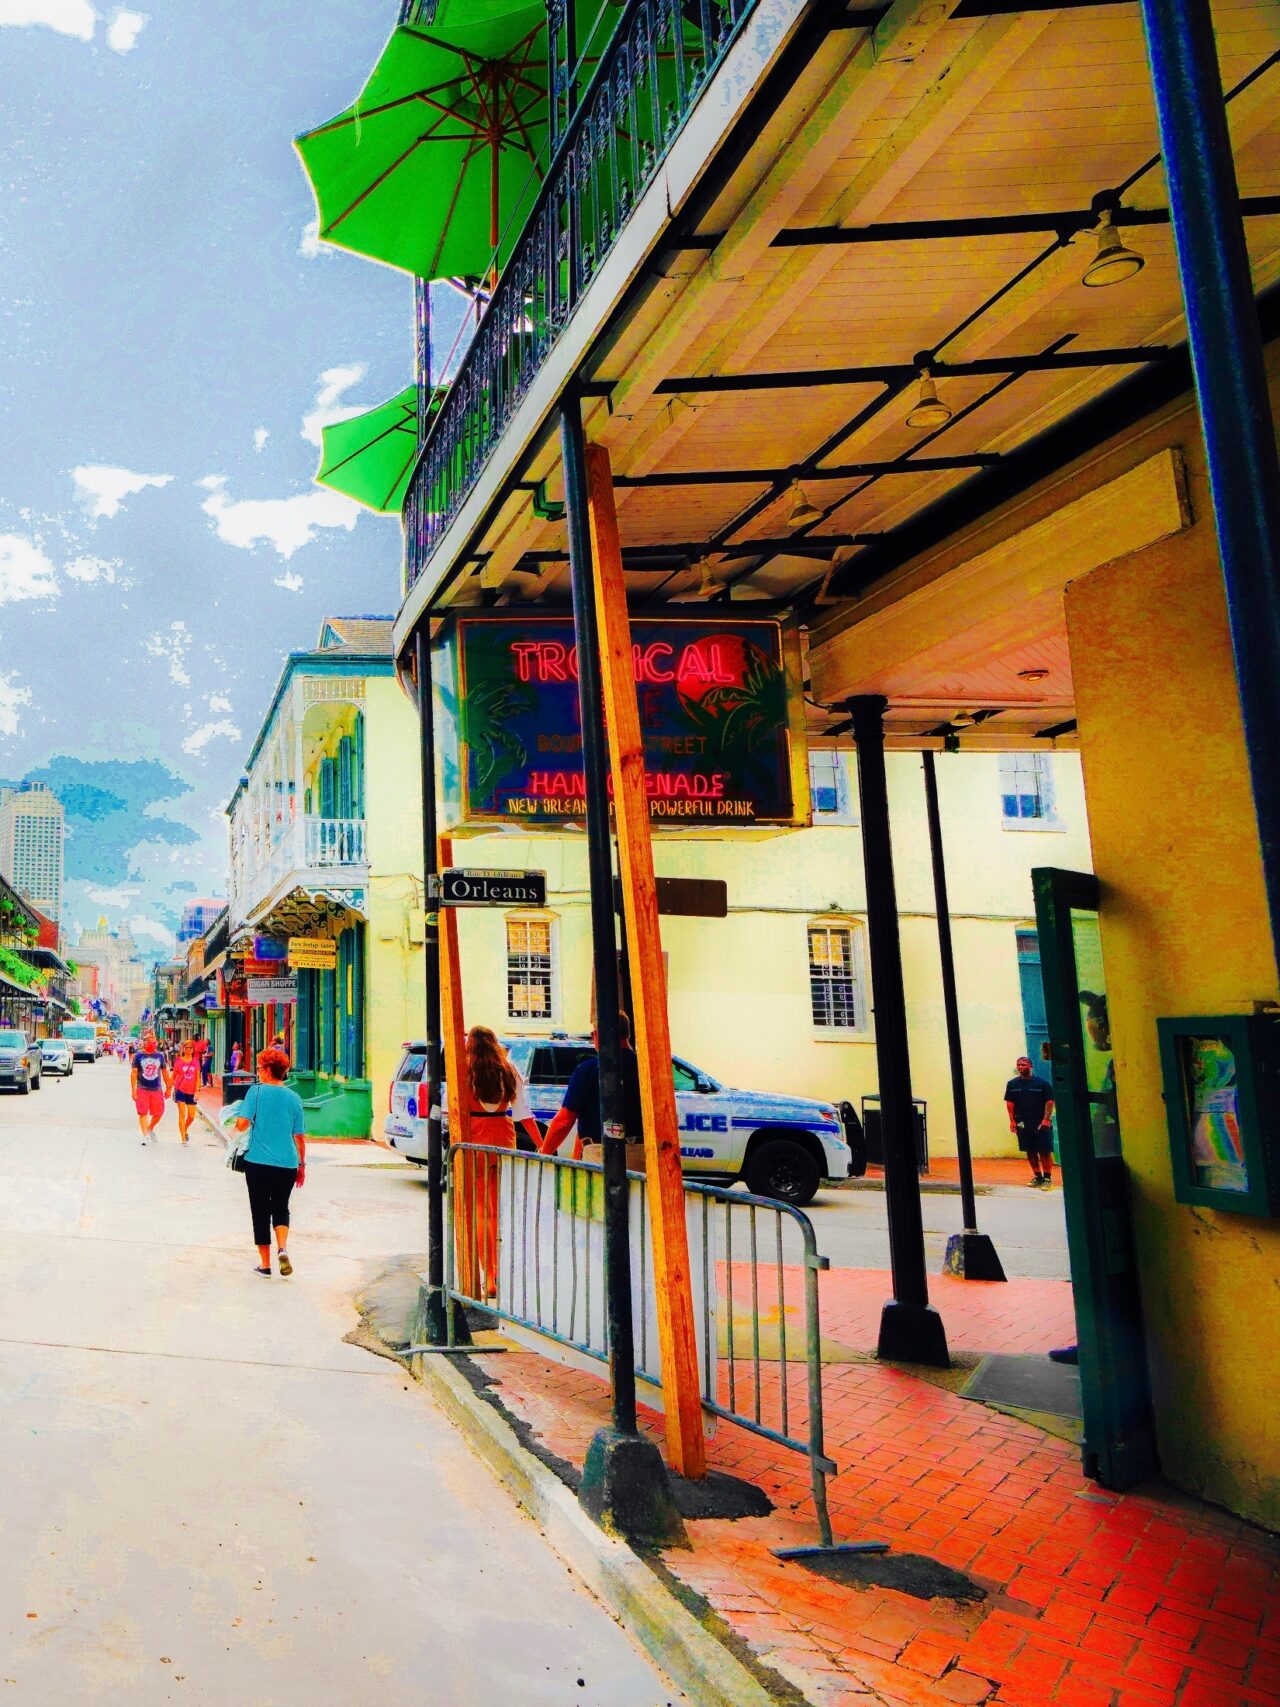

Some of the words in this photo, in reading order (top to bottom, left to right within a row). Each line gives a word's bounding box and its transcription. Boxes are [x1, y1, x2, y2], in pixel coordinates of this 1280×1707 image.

[510, 642, 735, 682] TRICAL
[646, 735, 708, 754] TREET
[531, 771, 587, 796] HAN
[508, 798, 538, 814] NEW
[543, 797, 587, 814] ORLEAN
[650, 800, 713, 816] POWERFUL
[718, 800, 755, 816] DRINK
[451, 880, 537, 899] Orleans
[249, 980, 269, 988] CIGAR
[271, 979, 296, 987] SHOPPE
